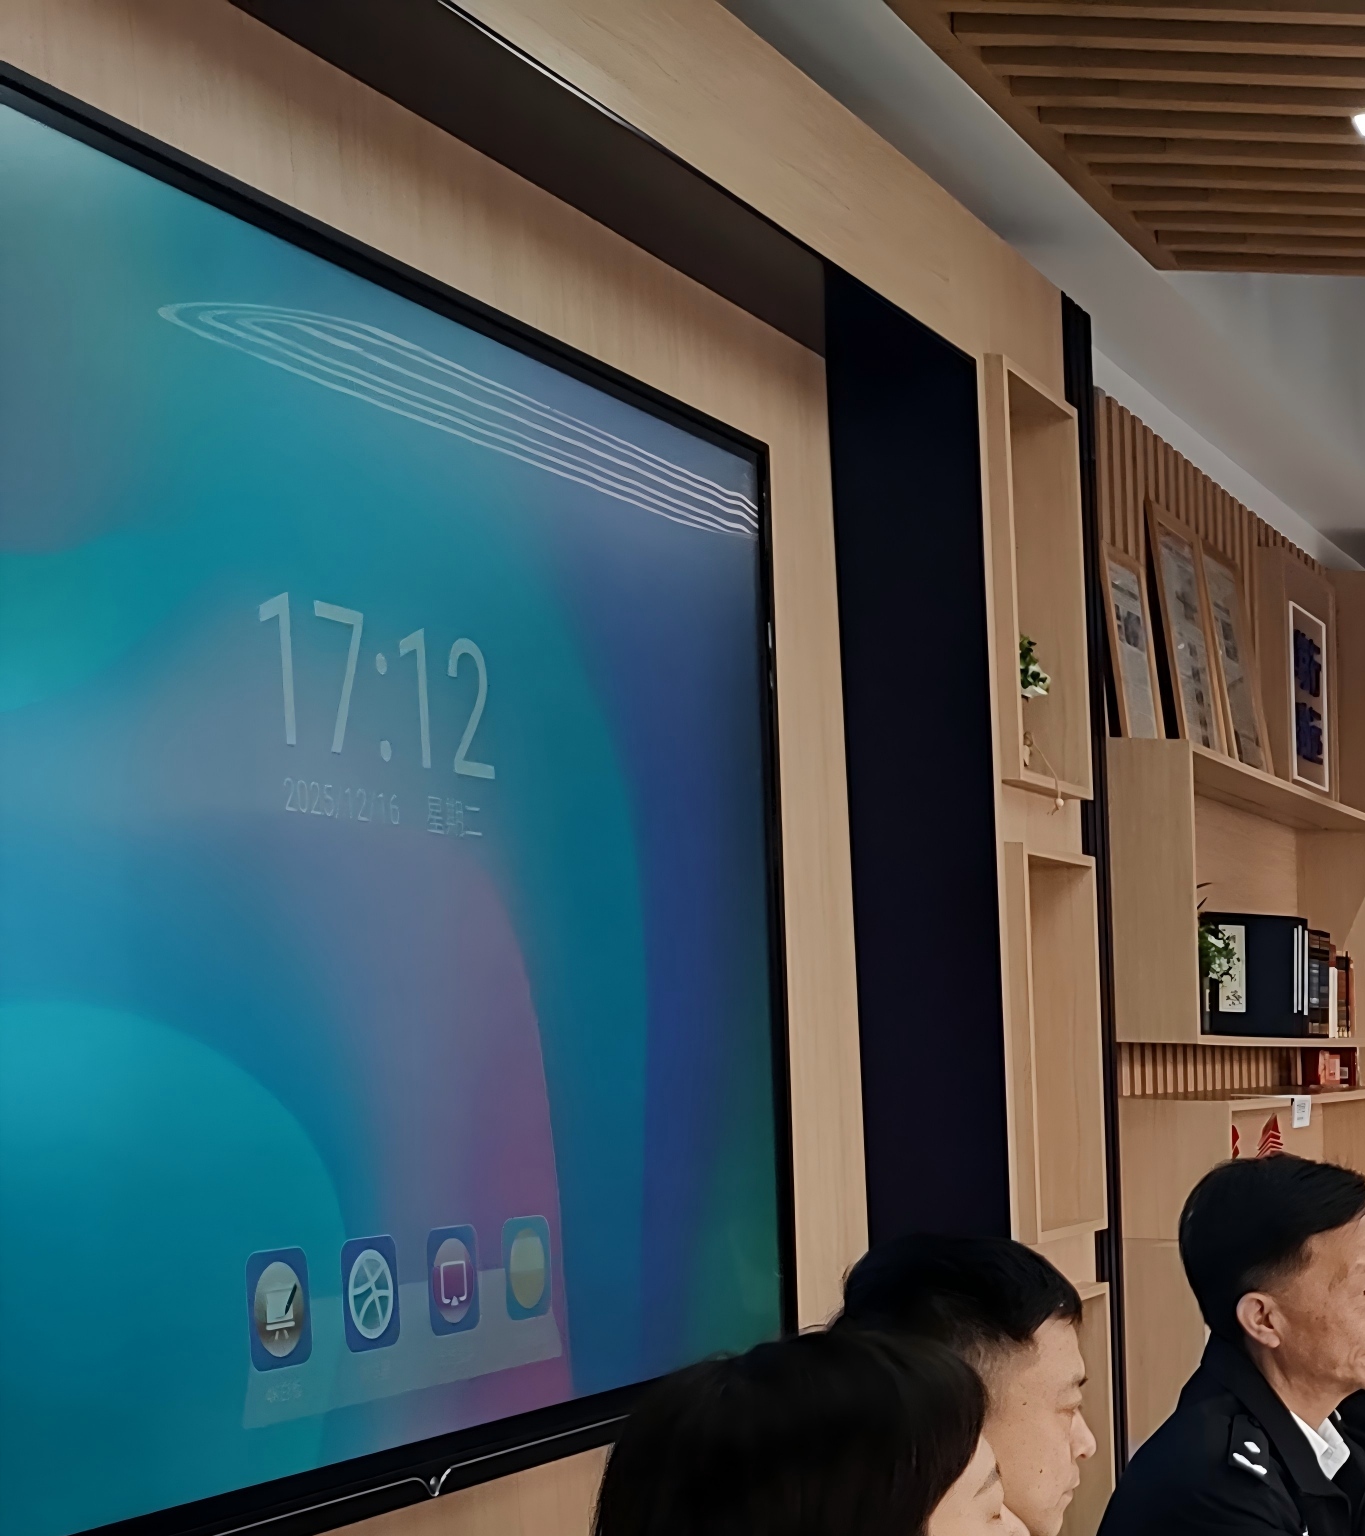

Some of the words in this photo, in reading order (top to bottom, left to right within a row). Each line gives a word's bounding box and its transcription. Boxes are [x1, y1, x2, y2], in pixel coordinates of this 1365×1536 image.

[258, 591, 496, 780] 17:12
[283, 777, 400, 825] 2025/12/16
[427, 795, 483, 837] 星期二
